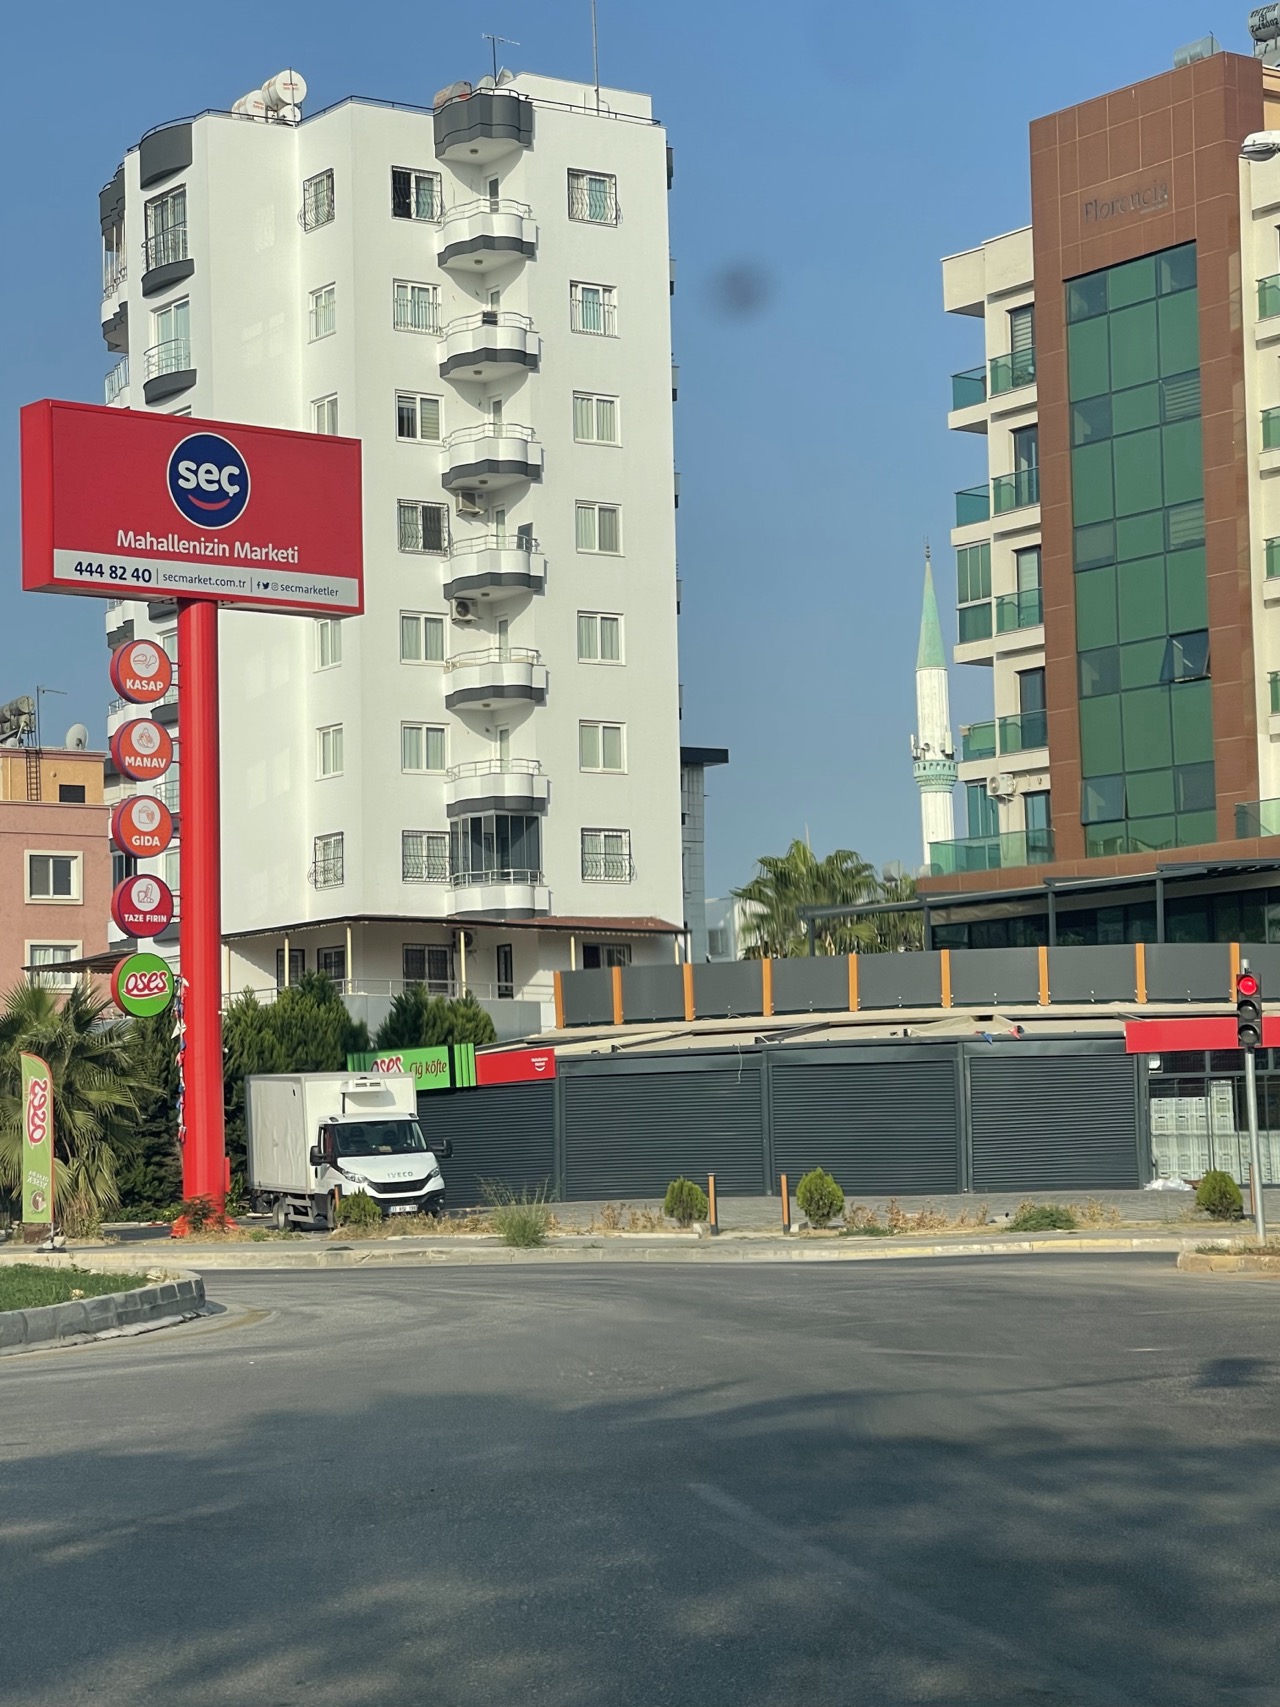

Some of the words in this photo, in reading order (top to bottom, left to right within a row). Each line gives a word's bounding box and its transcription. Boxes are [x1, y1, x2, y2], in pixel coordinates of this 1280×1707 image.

[177, 460, 241, 497] seç
[116, 529, 231, 558] Mahallenizin
[233, 541, 299, 564] Marketi
[74, 561, 105, 578] 444
[109, 564, 127, 581] 82
[131, 567, 152, 583] 40
[162, 571, 247, 590] secmarket.com.tr
[280, 582, 339, 597] secmarketler
[125, 678, 164, 692] KASAP
[124, 755, 167, 769] MANAV
[131, 835, 161, 847] GIDA
[124, 913, 144, 923] TAZE
[146, 913, 167, 923] FIRIN
[124, 971, 168, 996] oses
[425, 1058, 447, 1080] köfte
[387, 1171, 414, 1179] IVECO
